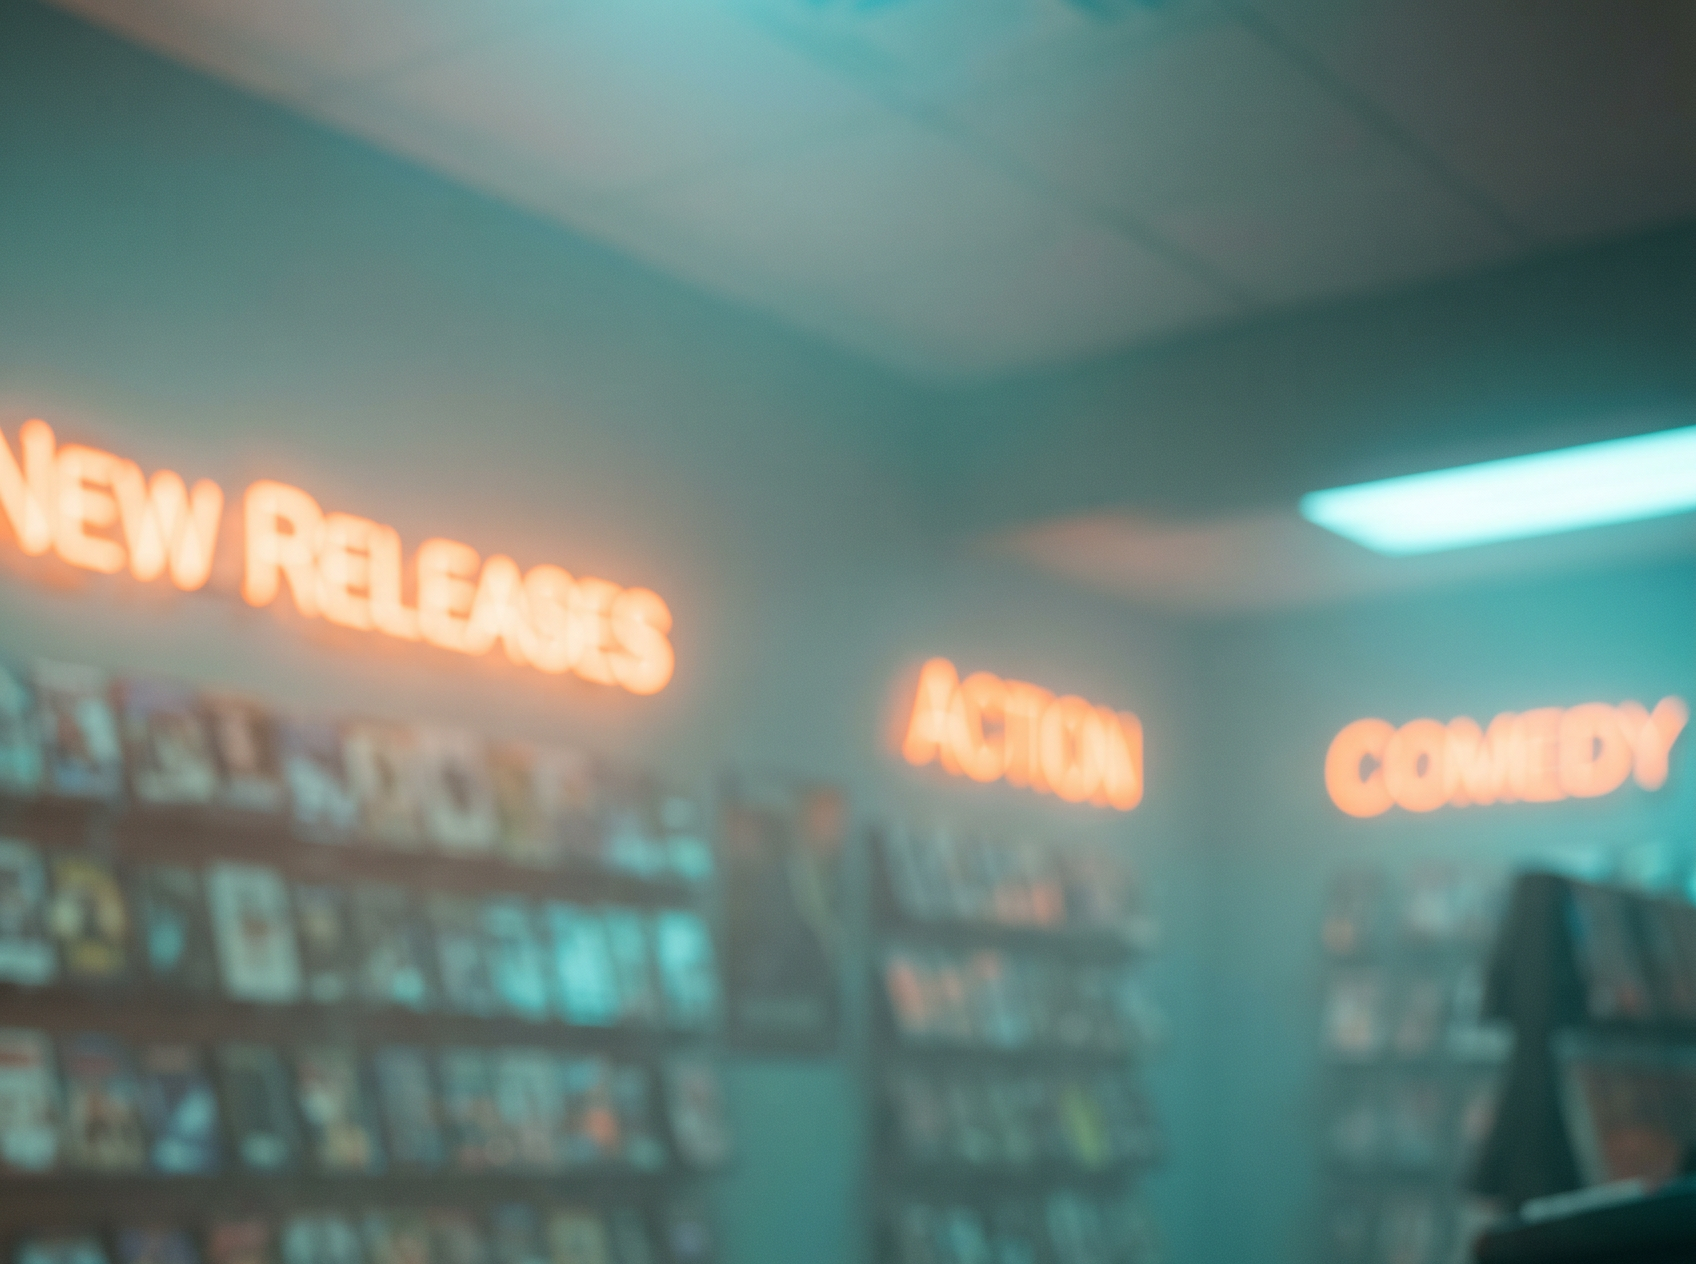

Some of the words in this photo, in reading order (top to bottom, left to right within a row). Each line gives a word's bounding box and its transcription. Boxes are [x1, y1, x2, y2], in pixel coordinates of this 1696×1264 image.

[0, 418, 224, 592] NEW
[242, 479, 675, 695] RELEASES
[902, 657, 1144, 812] ACTION
[1324, 695, 1689, 818] COMEDY
